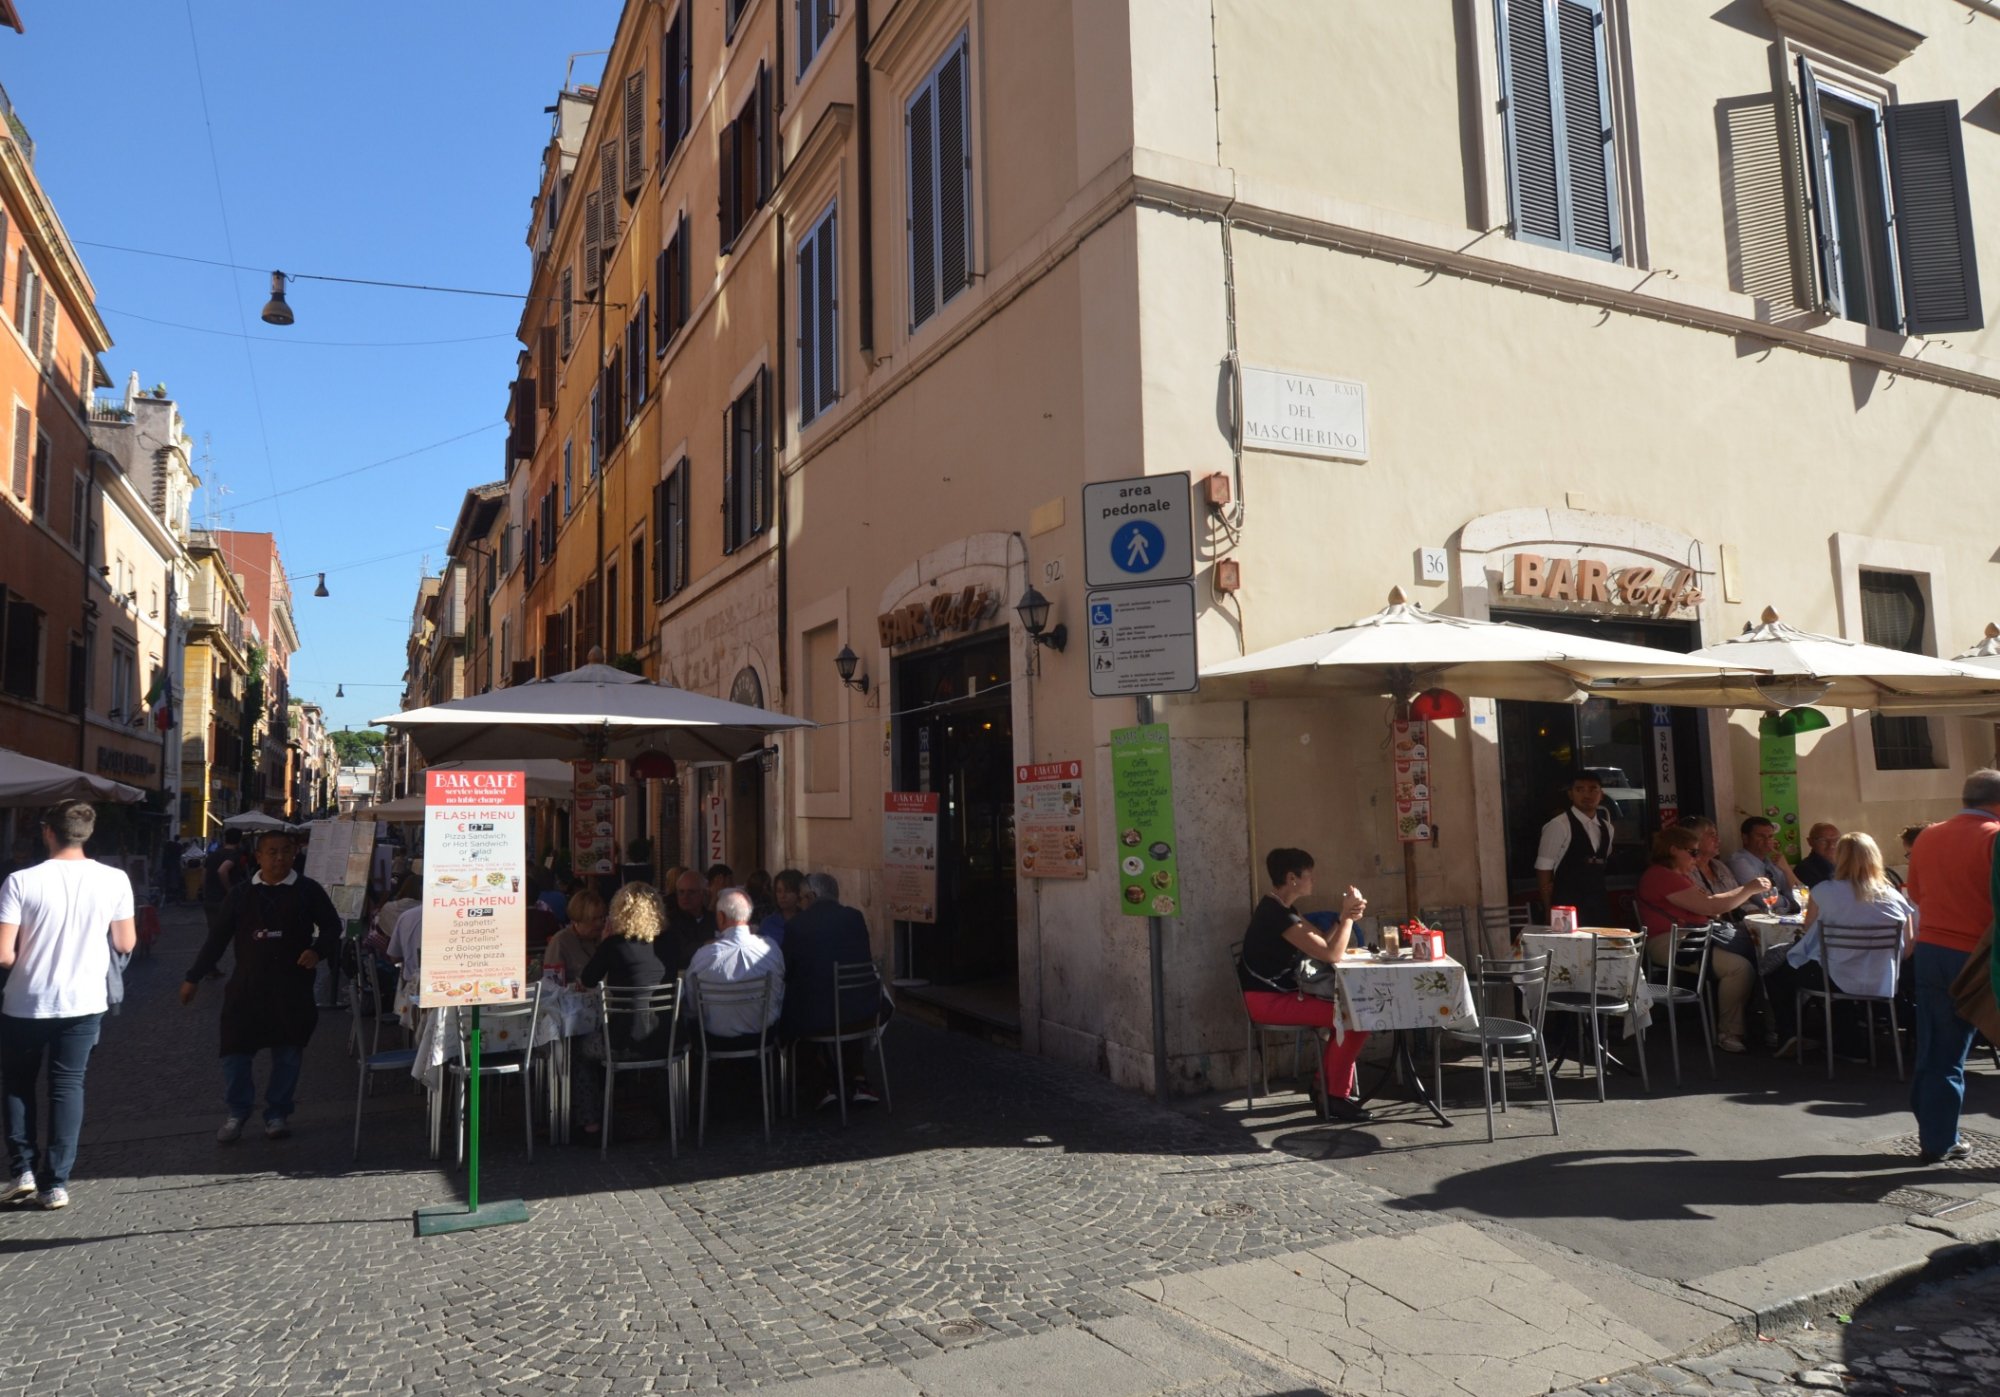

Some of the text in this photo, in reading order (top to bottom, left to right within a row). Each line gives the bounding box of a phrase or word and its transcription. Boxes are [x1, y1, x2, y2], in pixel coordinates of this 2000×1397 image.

[1286, 380, 1315, 397] VIA
[1288, 404, 1316, 419] DEL
[1246, 421, 1358, 448] MASCHERINO
[1120, 486, 1152, 498] area
[1102, 499, 1171, 519] pedonale
[1045, 560, 1061, 584] 92
[1426, 554, 1445, 575] 36
[1514, 553, 1609, 602] BAR
[878, 603, 926, 648] BAR
[1660, 731, 1670, 784] SNACK
[434, 774, 470, 788] BAR
[1659, 794, 1678, 804] BAR
[435, 811, 516, 820] FLASH MENU
[458, 824, 465, 832] €
[433, 896, 516, 907] FLASH MENU
[456, 908, 464, 918] €
